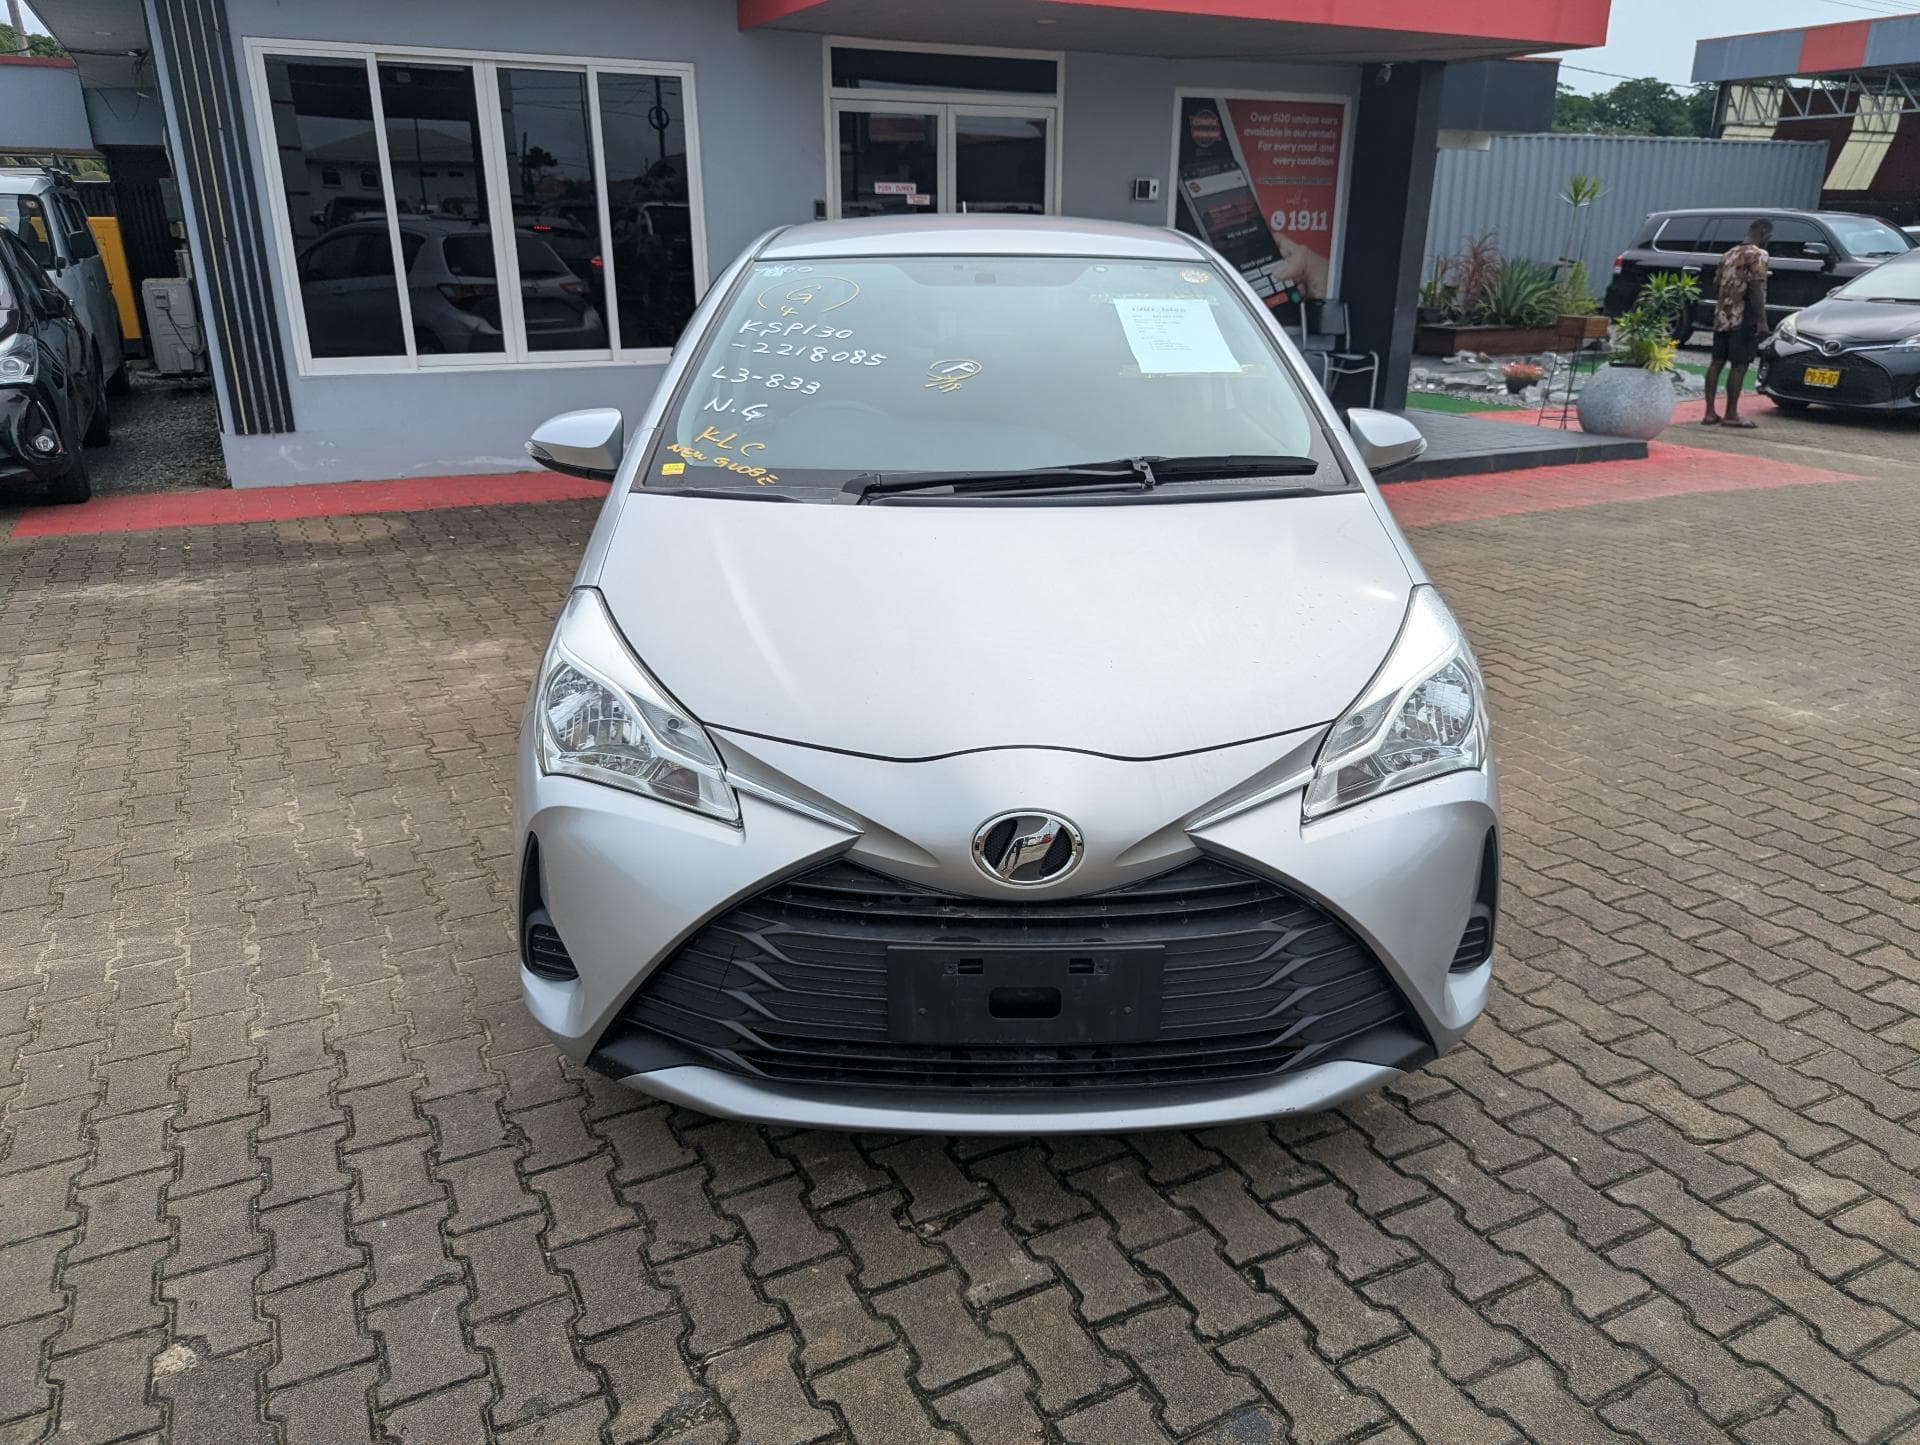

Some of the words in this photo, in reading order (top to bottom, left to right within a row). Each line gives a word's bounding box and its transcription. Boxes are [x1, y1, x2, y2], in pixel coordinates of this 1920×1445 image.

[1250, 112, 1271, 123] Over
[1273, 113, 1290, 123] 500
[1292, 113, 1319, 125] unique
[1244, 127, 1282, 137] available
[1293, 130, 1308, 138] our
[1257, 141, 1272, 151] For
[1273, 143, 1296, 153] every
[1319, 143, 1335, 152] and
[1273, 157, 1296, 167] every
[1297, 156, 1334, 167] condition
[1288, 210, 1328, 231] 1911
[731, 342, 887, 368] -2218085
